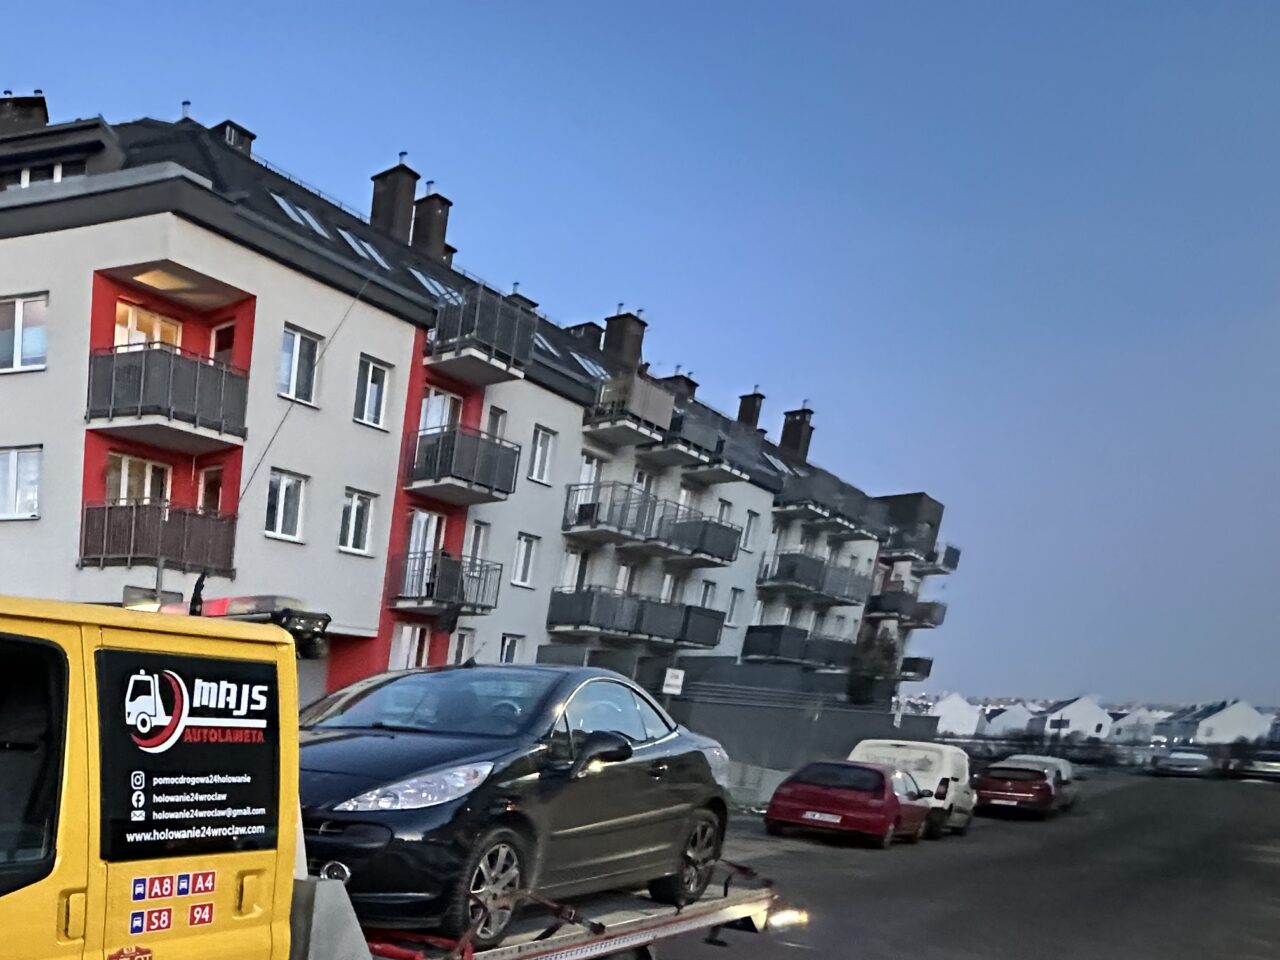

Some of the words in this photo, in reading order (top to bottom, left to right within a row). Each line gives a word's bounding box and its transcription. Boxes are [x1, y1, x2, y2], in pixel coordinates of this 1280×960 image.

[183, 728, 265, 743] AUTOLAWETA
[126, 825, 265, 842] www.holowanie24wroclaw.com
[151, 878, 171, 897] A8
[195, 874, 213, 892] A4
[150, 911, 168, 929] S8
[193, 905, 210, 924] 94
